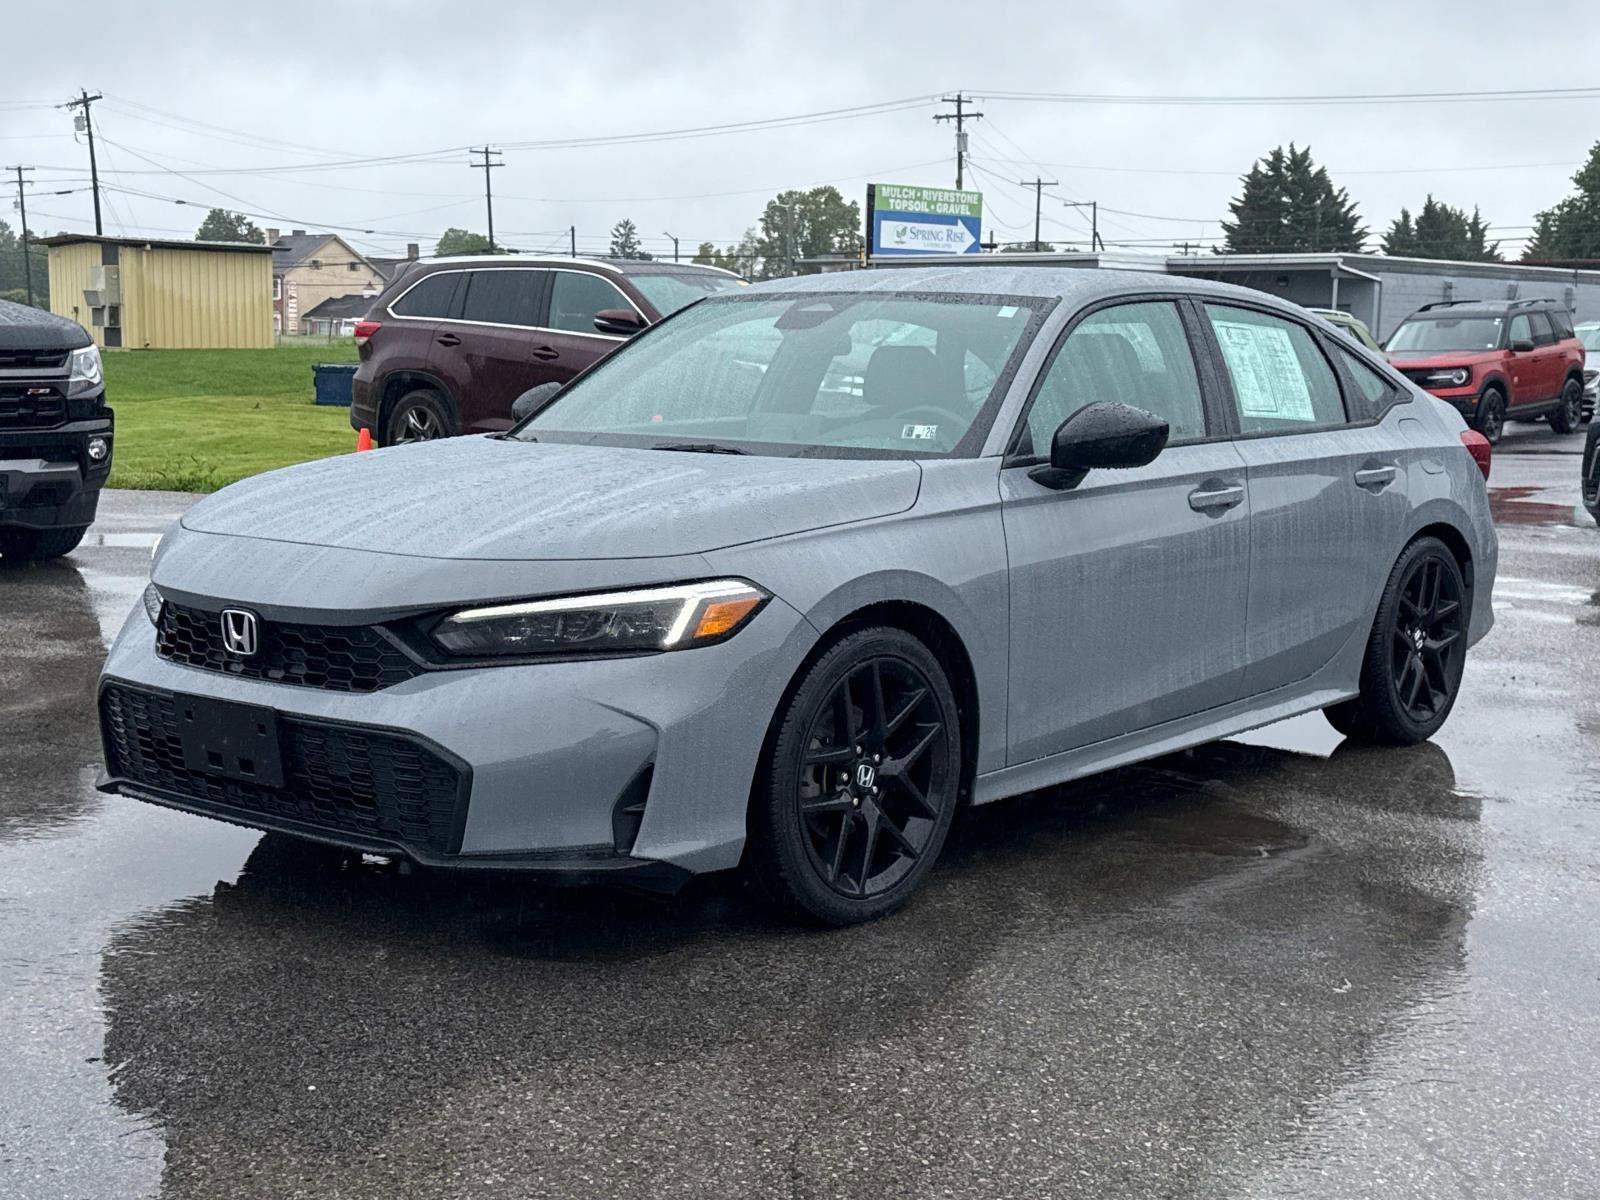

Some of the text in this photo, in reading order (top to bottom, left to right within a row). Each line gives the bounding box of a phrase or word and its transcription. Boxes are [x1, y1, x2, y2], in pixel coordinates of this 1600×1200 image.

[881, 186, 915, 199] MULCH
[888, 199, 971, 215] TOPSOIL GRAVEL
